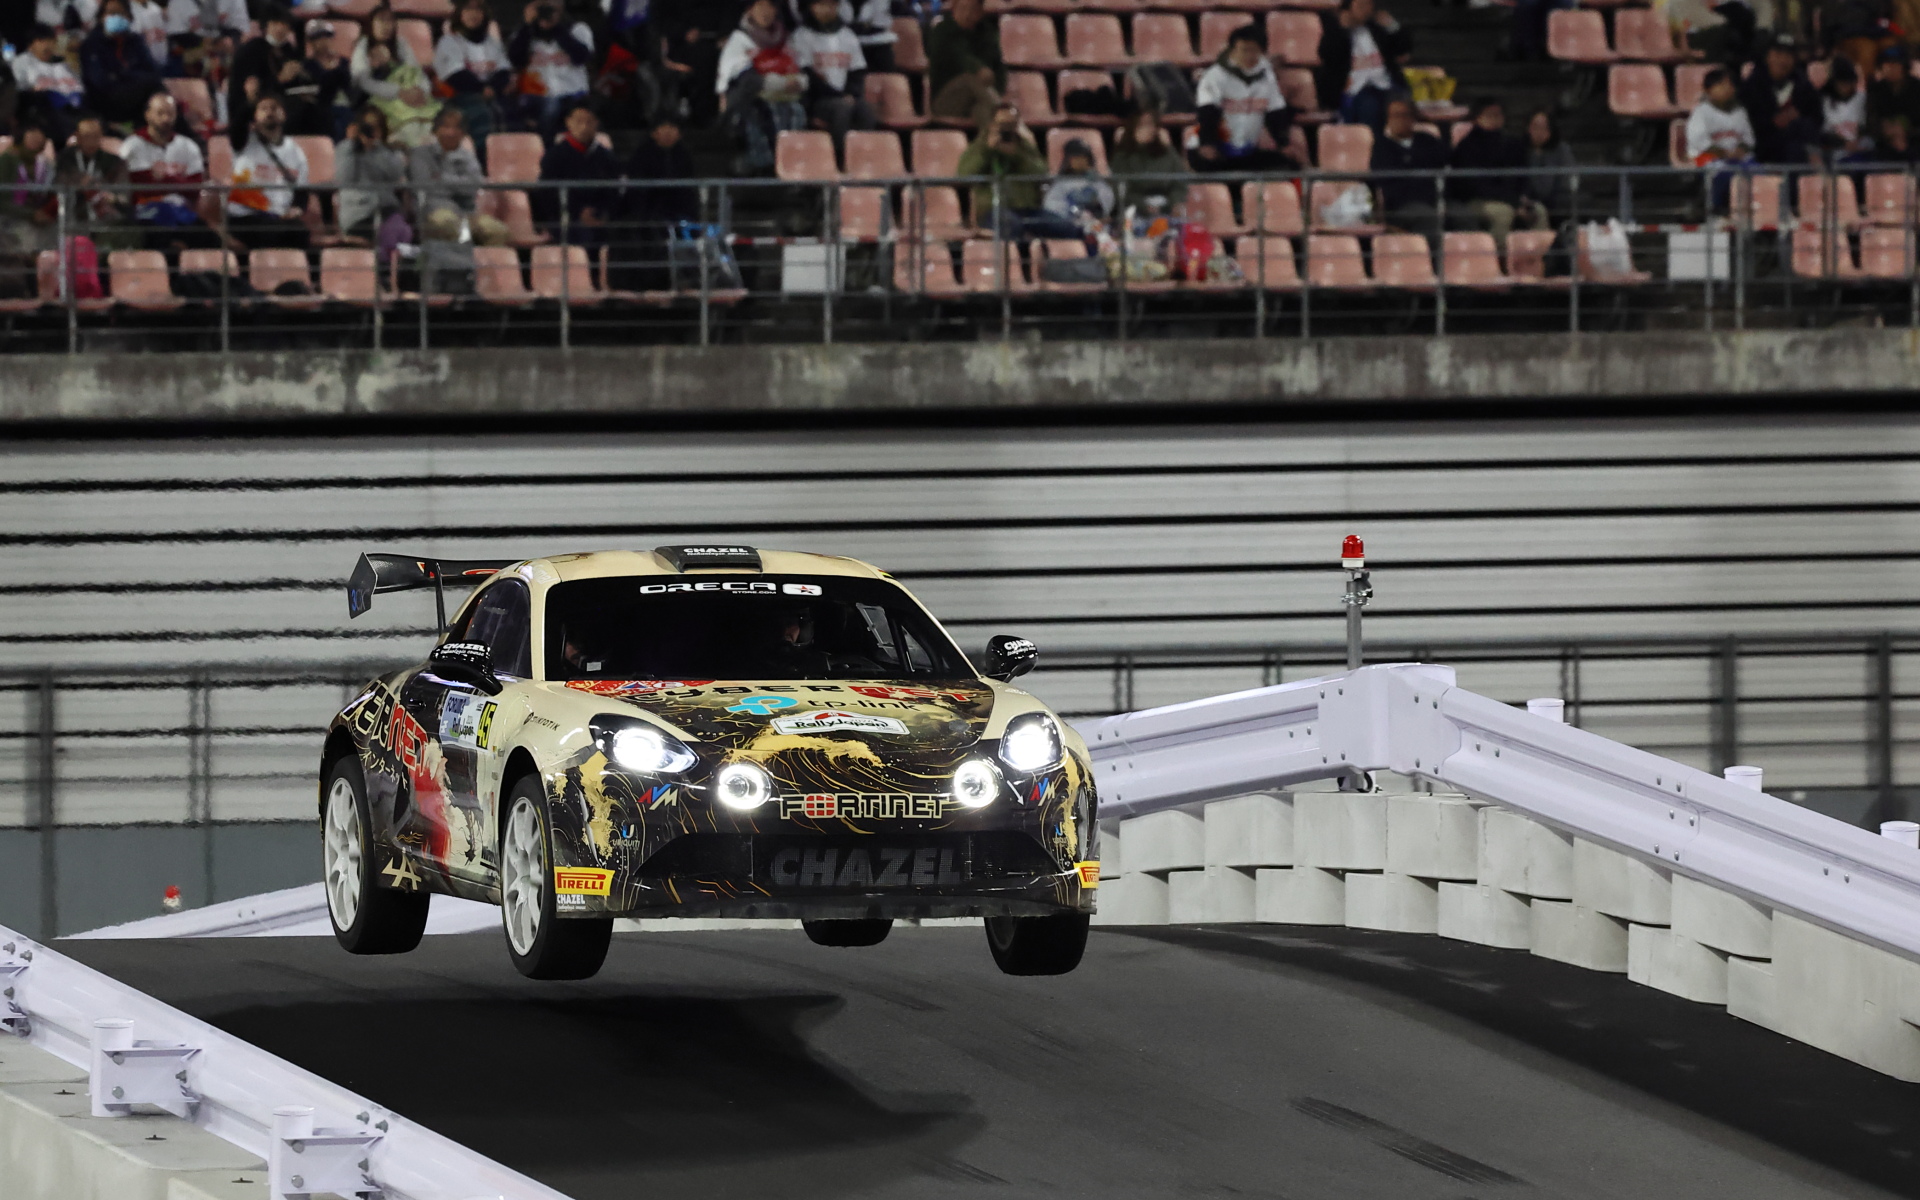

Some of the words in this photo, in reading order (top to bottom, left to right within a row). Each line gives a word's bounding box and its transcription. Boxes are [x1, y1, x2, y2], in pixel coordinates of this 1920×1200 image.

[639, 582, 777, 594] ORECA
[443, 642, 486, 652] CHAZEL
[808, 700, 921, 712] tp-link
[477, 701, 498, 749] 45
[637, 783, 679, 811] AVM
[1030, 777, 1056, 806] AVM
[780, 792, 951, 820] FORTINET
[770, 848, 962, 887] CHAZEL
[556, 872, 607, 890] PIRELLI
[556, 893, 586, 905] CHAZEL
